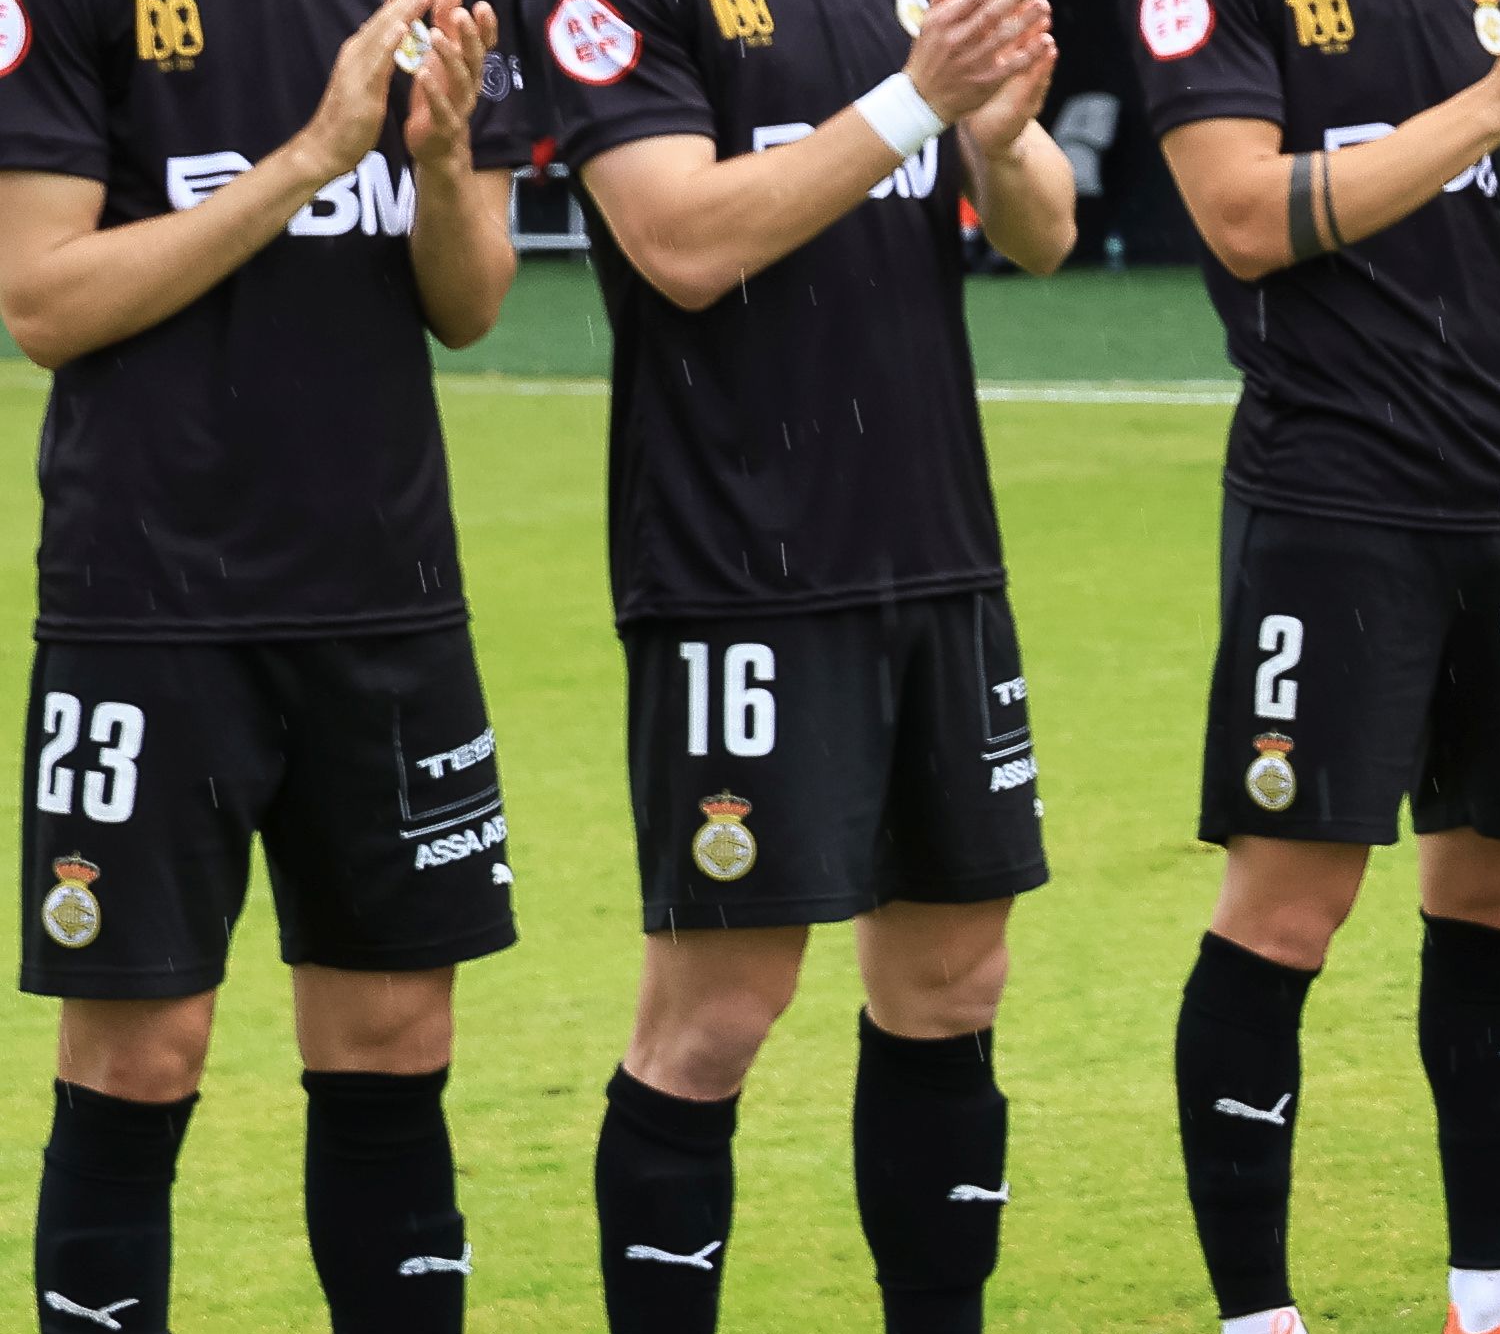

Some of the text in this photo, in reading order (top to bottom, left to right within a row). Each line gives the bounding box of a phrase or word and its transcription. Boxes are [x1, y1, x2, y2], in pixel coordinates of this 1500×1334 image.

[678, 641, 776, 757] 16
[1254, 614, 1304, 721] 2
[36, 691, 146, 824] 23
